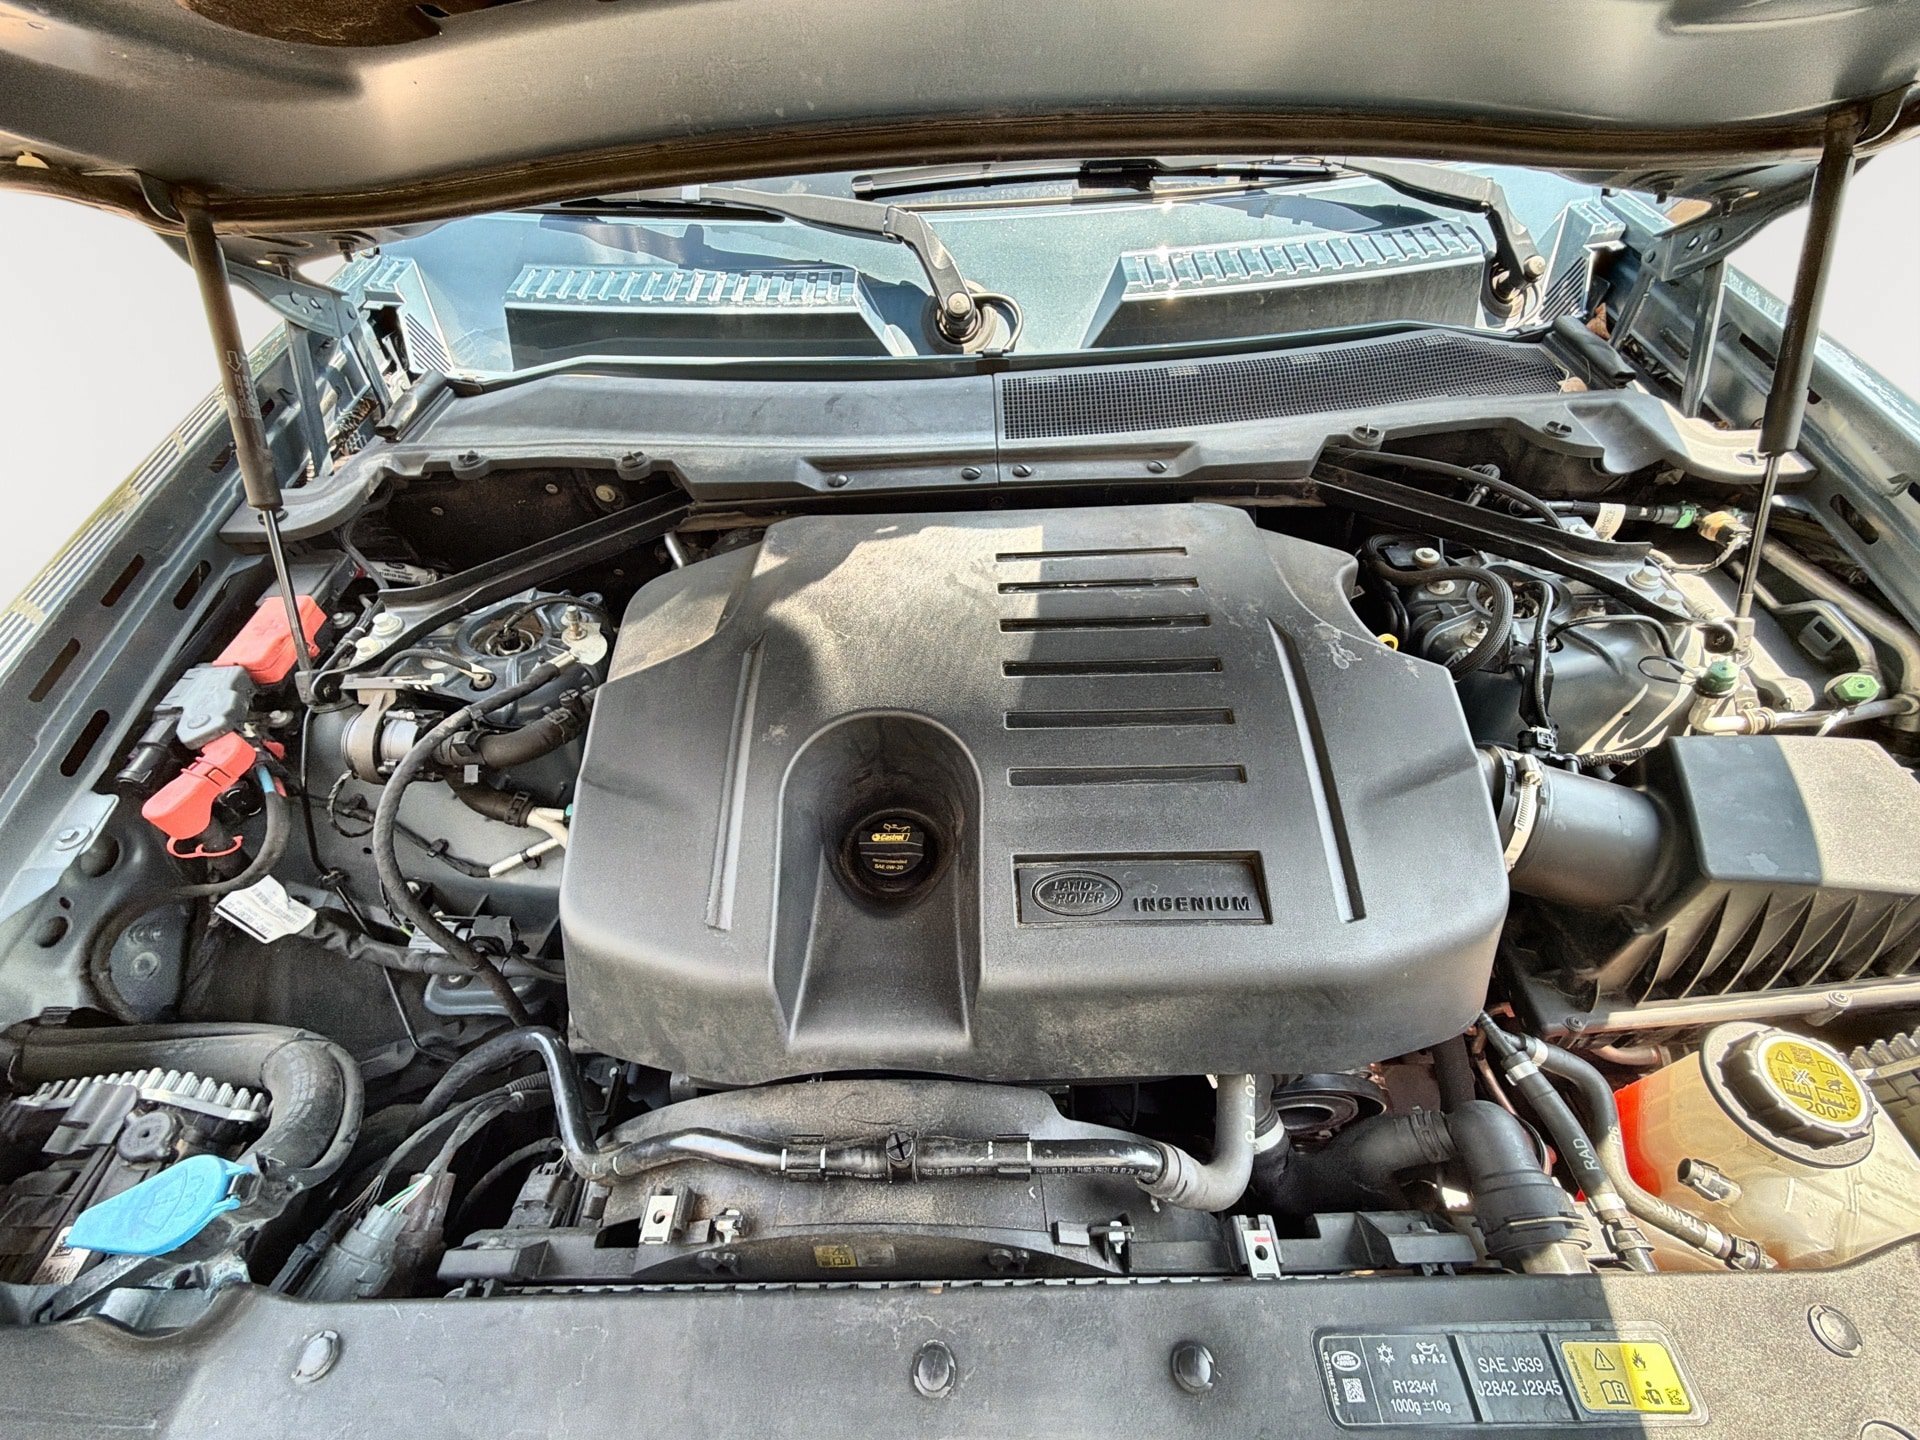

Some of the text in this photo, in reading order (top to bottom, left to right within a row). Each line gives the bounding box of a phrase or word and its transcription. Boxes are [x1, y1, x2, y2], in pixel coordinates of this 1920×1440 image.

[880, 833, 904, 841] Castrol
[1053, 880, 1093, 891] LAND
[1058, 892, 1106, 904] ROVER
[1133, 896, 1251, 912] INGENIUM
[1803, 1100, 1838, 1119] 200
[1572, 1138, 1600, 1171] RAD
[1655, 1200, 1698, 1231] TANK
[1477, 1357, 1544, 1373] SAE J639
[1392, 1380, 1438, 1396] R1234yf
[1477, 1380, 1563, 1397] J2842 J2845
[1390, 1399, 1452, 1415] 1000g ±10g
